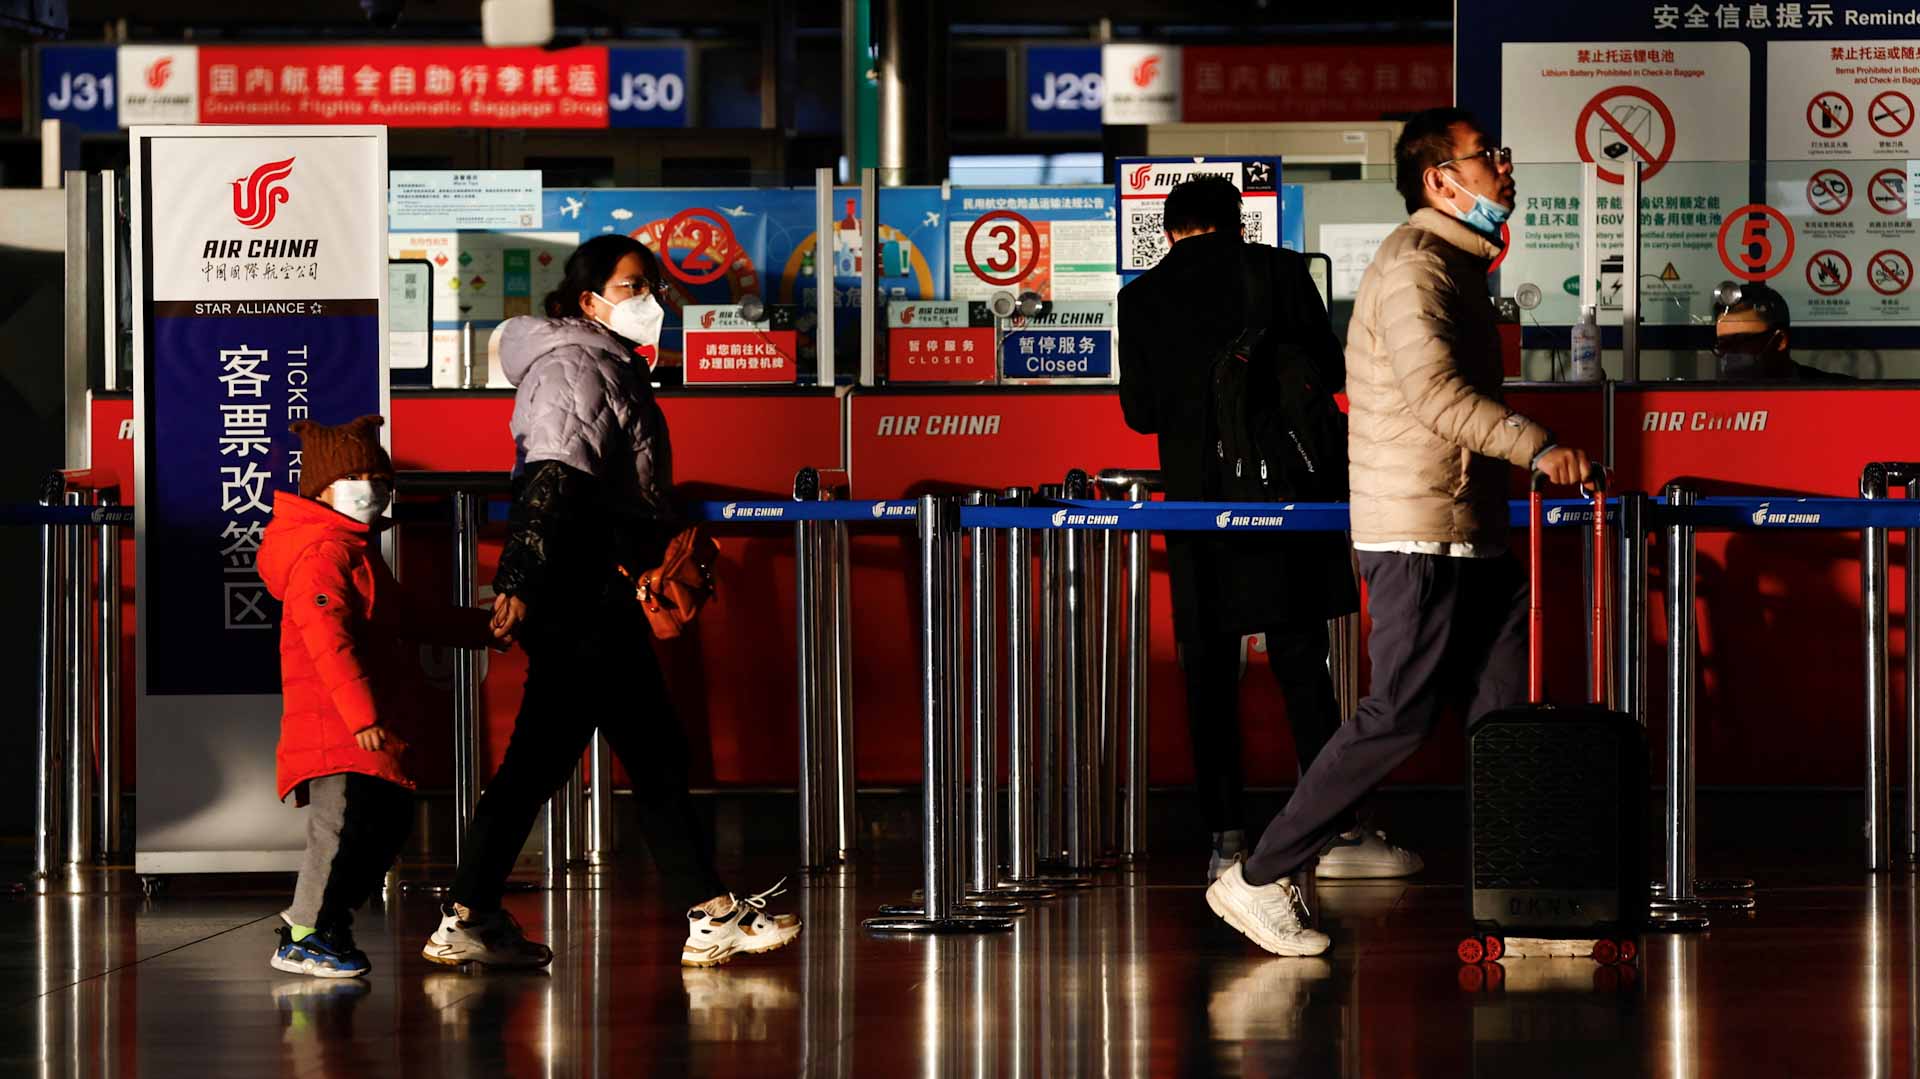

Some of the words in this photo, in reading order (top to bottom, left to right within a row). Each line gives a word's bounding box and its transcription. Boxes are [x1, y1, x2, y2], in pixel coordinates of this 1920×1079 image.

[1653, 4, 1834, 30] 安全信息提示
[1577, 50, 1675, 63] 禁止托运锂电池
[1541, 69, 1568, 77] Lithium
[1570, 69, 1594, 78] Battery
[1596, 69, 1632, 77] Prohibited
[1634, 69, 1640, 77] in
[1674, 69, 1704, 78] Baggage
[1857, 66, 1893, 74] Prohibited
[1894, 66, 1901, 74] in
[209, 64, 598, 95] 国内航班全自助行李托运
[47, 73, 114, 110] J31
[608, 72, 683, 111] J30
[1030, 72, 1102, 110] J29
[1154, 173, 1182, 186] AIR
[202, 240, 243, 258] AIR
[247, 239, 319, 258] CHINA
[681, 222, 713, 269] 2
[986, 225, 1017, 272] 3
[1740, 219, 1772, 268] 5
[195, 303, 232, 315] STAR
[236, 303, 305, 315] ALLIANCE
[918, 307, 932, 315] AIR
[933, 307, 959, 315] CHINA
[1032, 312, 1057, 324] AIR
[1060, 312, 1104, 324] CHINA
[706, 343, 777, 356] 请您前往K区
[908, 340, 975, 352] 暂停服务
[1018, 336, 1096, 355] 暂停服务
[699, 357, 784, 370] 办理国内登机牌
[908, 356, 975, 365] CLOSED
[1026, 357, 1088, 373] Closed
[287, 345, 309, 421] TICKE
[877, 415, 921, 436] AIR
[925, 415, 1001, 435] CHINA
[1642, 411, 1686, 432] AIR
[217, 344, 274, 630] 客票改签区
[736, 507, 754, 517] AIR
[754, 507, 783, 517] CHINA
[886, 506, 902, 516] AIR
[1562, 511, 1581, 521] AIR
[1067, 514, 1085, 525] AIR
[1087, 514, 1119, 525] CHINA
[1231, 516, 1251, 526] AIR
[1251, 516, 1284, 527] CHINA
[1767, 513, 1786, 524] AIR
[1787, 513, 1820, 524] CHINA
